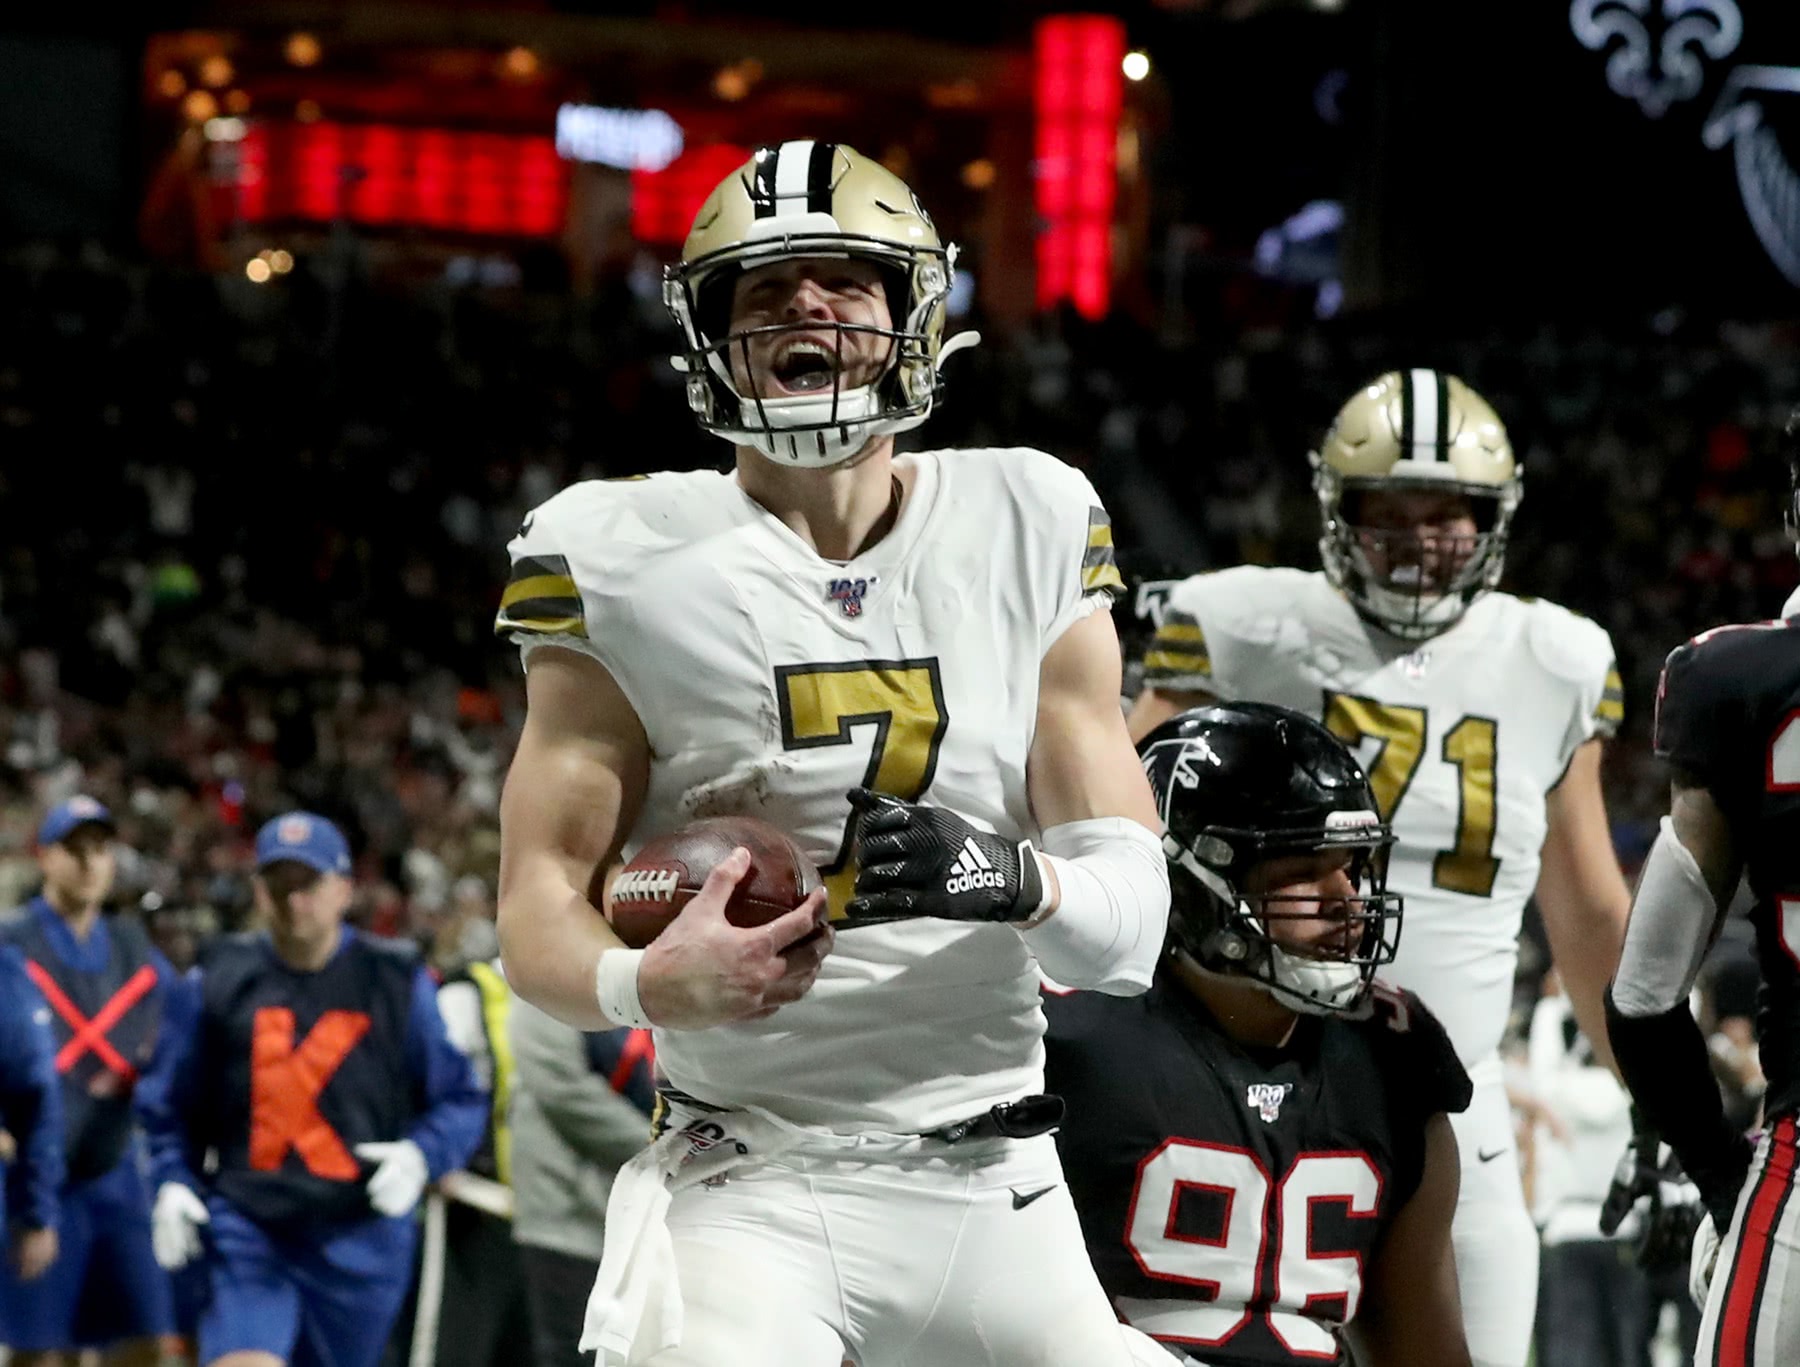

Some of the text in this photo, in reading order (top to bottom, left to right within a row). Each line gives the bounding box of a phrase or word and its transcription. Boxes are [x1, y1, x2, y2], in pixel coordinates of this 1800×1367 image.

[774, 656, 950, 931] 7
[946, 868, 1006, 894] adidas
[1322, 688, 1503, 898] 71
[248, 1006, 371, 1182] K
[1114, 1135, 1385, 1360] 96
